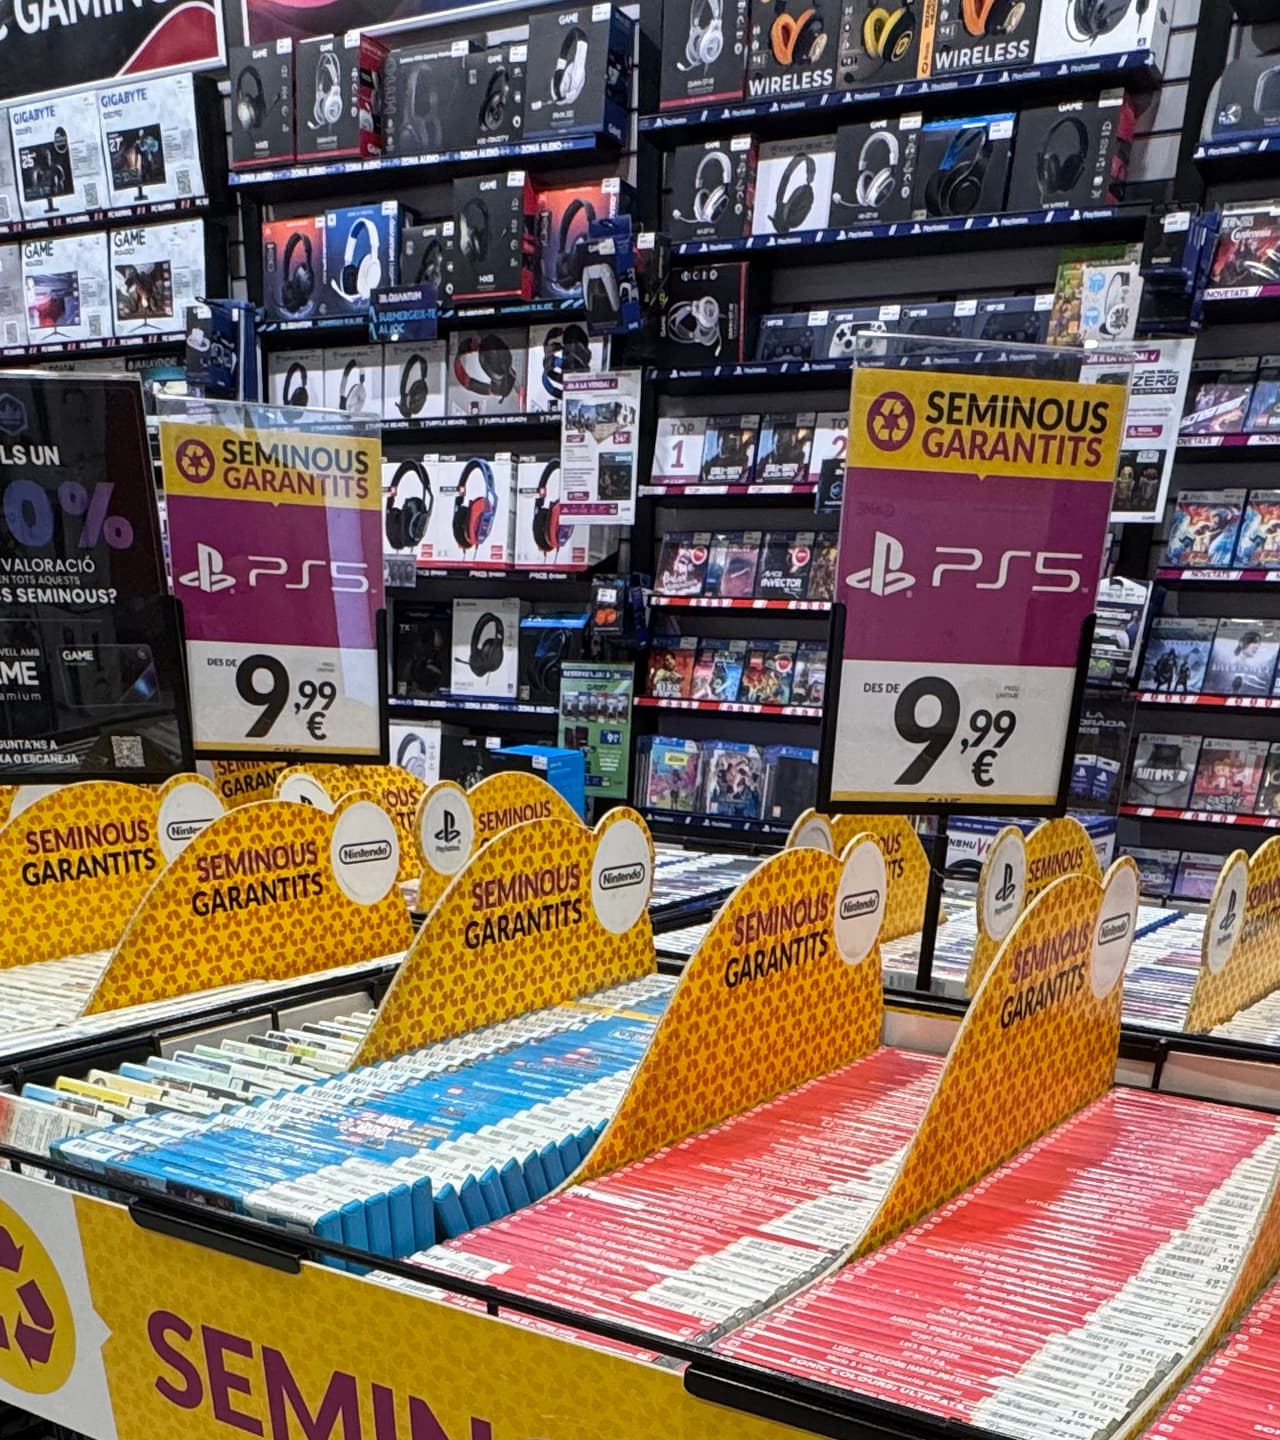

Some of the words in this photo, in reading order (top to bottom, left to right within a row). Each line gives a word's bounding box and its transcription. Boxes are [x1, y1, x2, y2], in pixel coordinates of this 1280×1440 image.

[935, 41, 1031, 71] WIRELESS
[748, 69, 834, 97] WIRELESS
[101, 88, 149, 109] GIGABYTE
[12, 105, 56, 126] GIGABYTE
[24, 241, 54, 259] GAME
[114, 229, 146, 249] GAME
[925, 390, 1109, 434] SEMINOUS
[31, 446, 60, 466] UN
[222, 439, 369, 474] SEMINOUS
[922, 427, 1102, 467] GARANTITS
[224, 467, 368, 499] GARANTITS
[1, 555, 95, 574] VALORACIÓ
[248, 556, 368, 593] PS5
[932, 546, 1083, 594] PS5
[11, 576, 35, 585] TOTS
[37, 576, 80, 585] AQUESTS
[16, 588, 117, 604] SEMINOUS?
[63, 650, 94, 661] GAME
[864, 682, 881, 695] DES
[884, 683, 900, 694] DE
[14, 754, 21, 763] O
[23, 753, 79, 764] ESCANEJA
[50, 740, 57, 750] A
[478, 801, 551, 831] SEMINOUS
[25, 821, 150, 855] SEMINOUS
[341, 841, 391, 863] Nintendo
[21, 848, 156, 886] GARANTITS
[195, 840, 319, 883] SEMINOUS
[1026, 848, 1084, 884] SEMINOUS
[471, 864, 581, 911] SEMINOUS
[601, 866, 645, 888] Nintendo
[191, 872, 323, 918] GARANTITS
[841, 892, 879, 916] Nintendo
[464, 900, 582, 950] GARANTITS
[732, 894, 830, 946] SEMINOUS
[1099, 916, 1130, 941] Nintendo
[724, 934, 830, 989] GARANTITS
[1010, 925, 1090, 985] SEMINOUS
[1000, 961, 1086, 1029] GARANTITS
